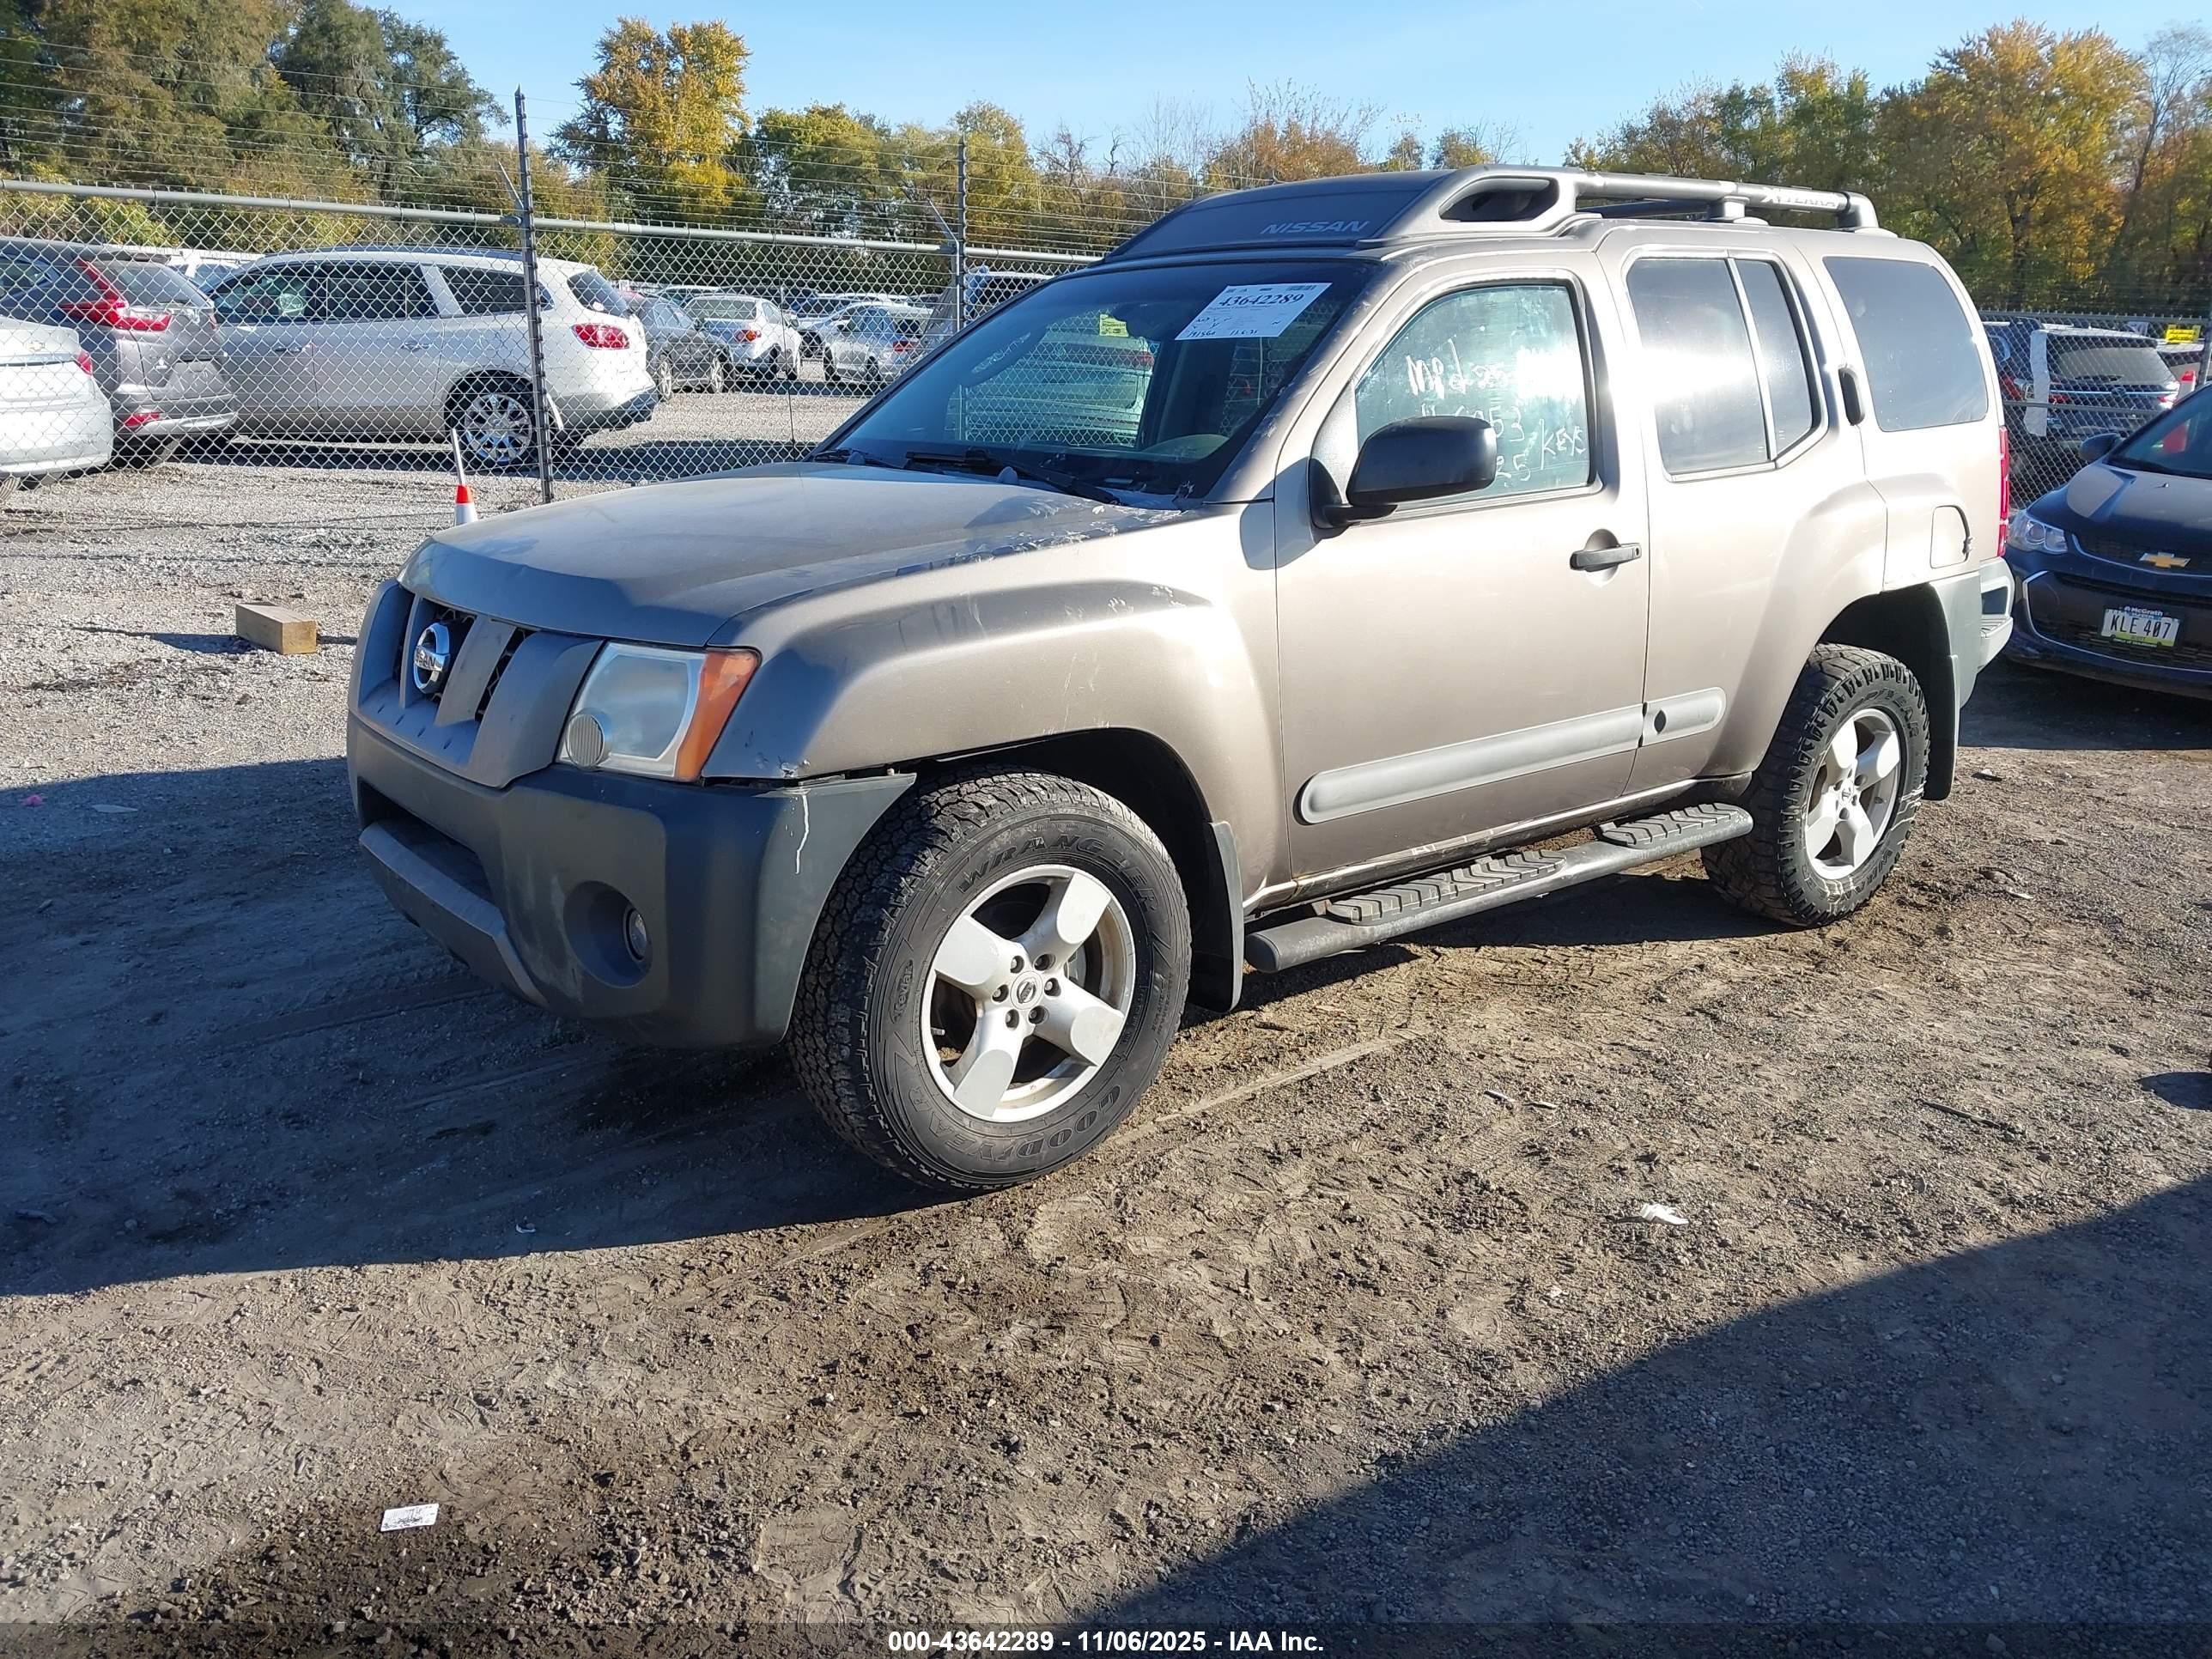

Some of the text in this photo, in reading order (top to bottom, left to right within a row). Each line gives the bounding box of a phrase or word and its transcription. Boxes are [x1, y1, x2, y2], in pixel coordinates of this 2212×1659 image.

[1260, 221, 1370, 234] NISSAN
[1218, 294, 1305, 307] 43642289
[2130, 607, 2164, 617] McGrath
[2110, 614, 2172, 640] KLE 407
[908, 1085, 1121, 1163] GOODYEAR
